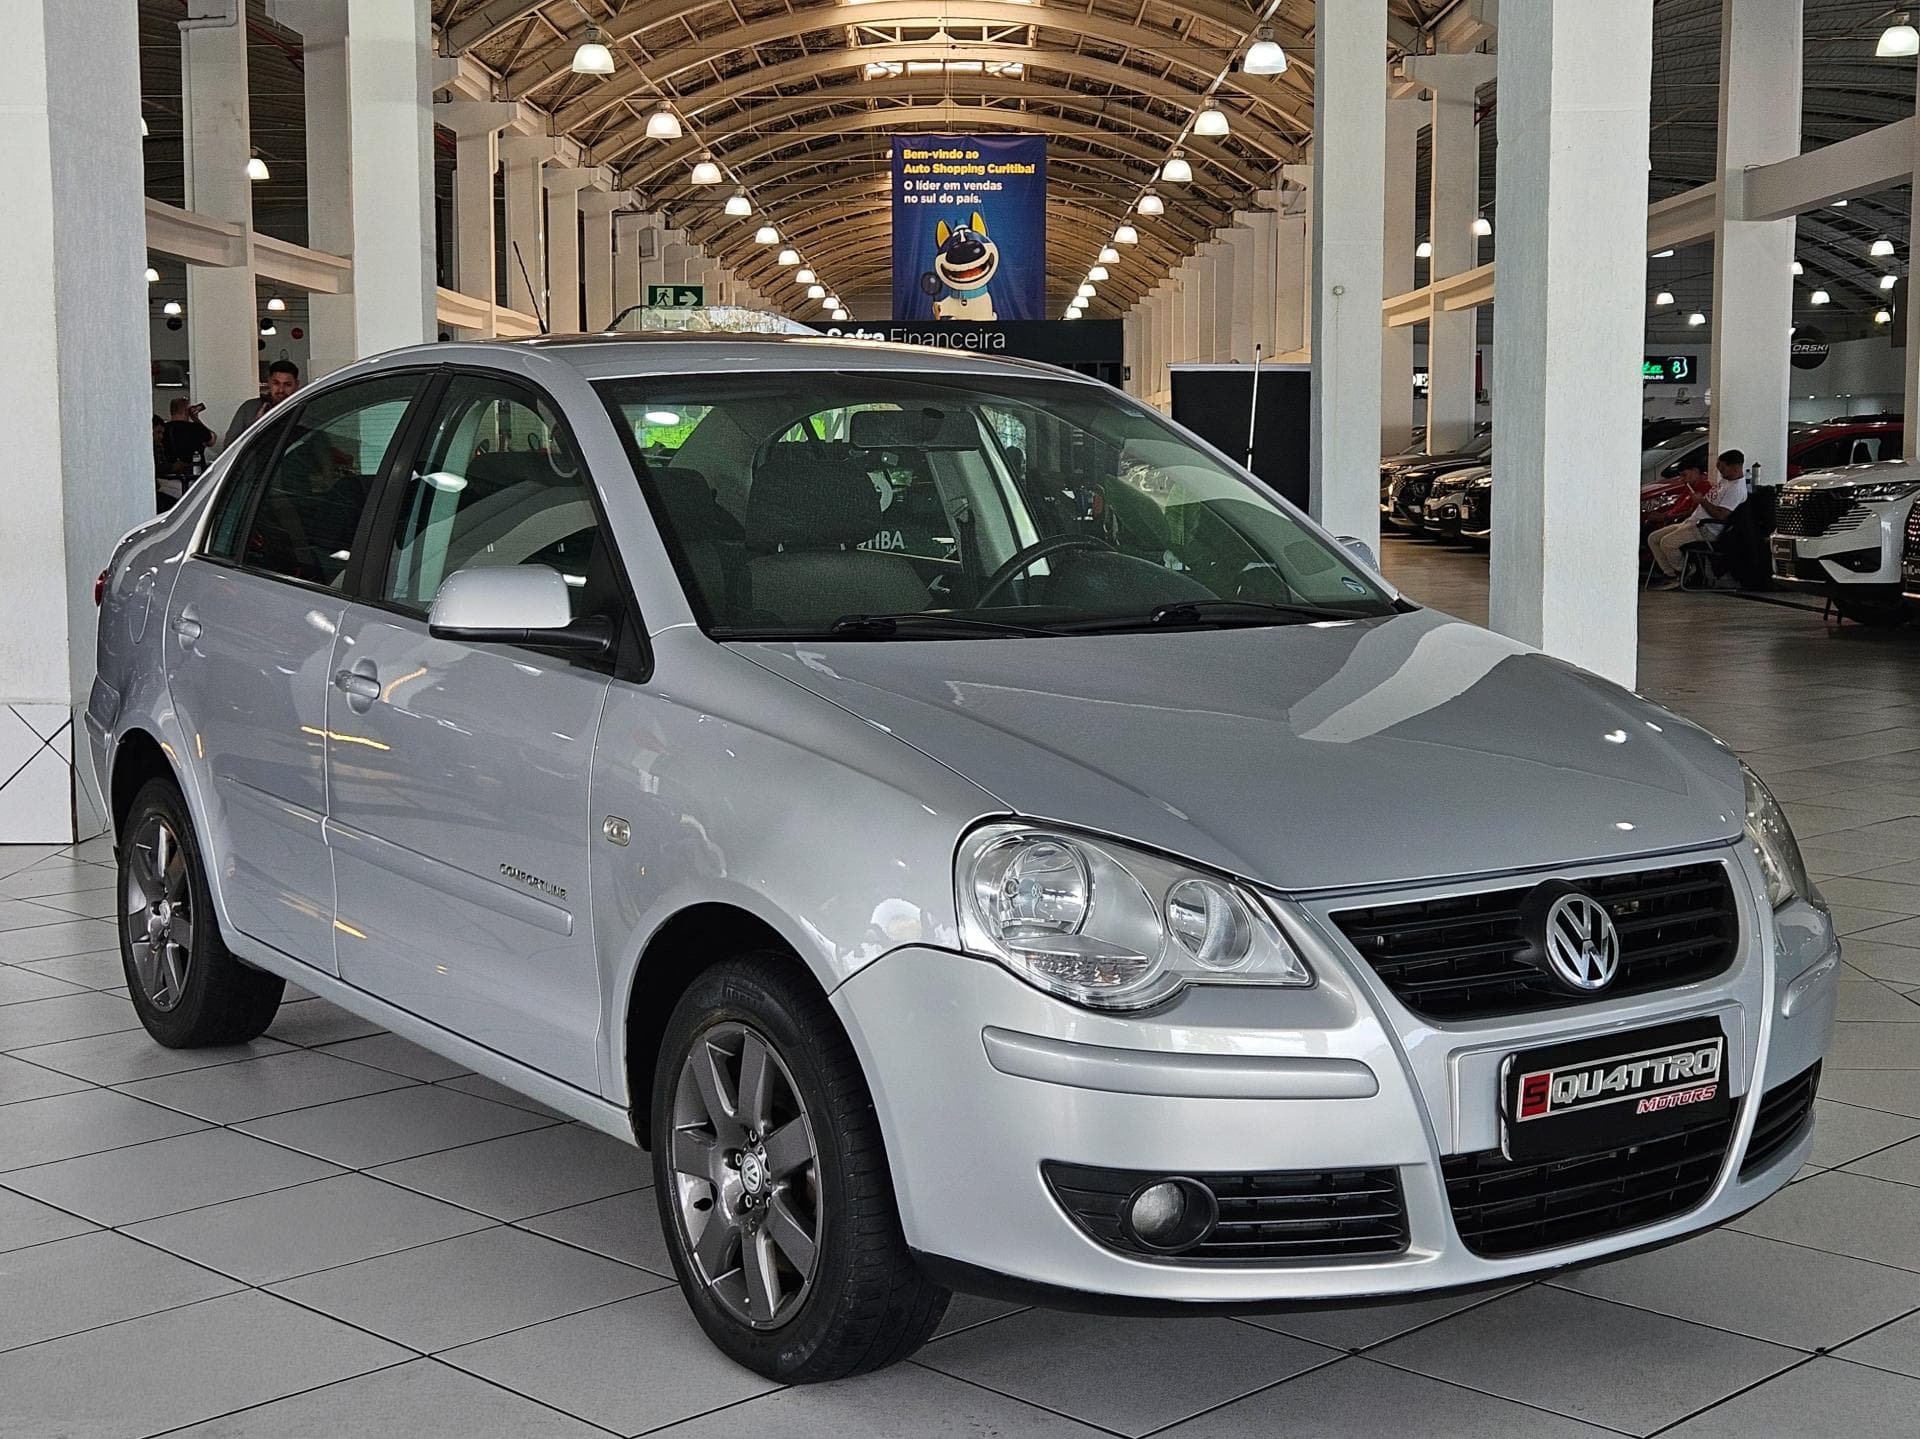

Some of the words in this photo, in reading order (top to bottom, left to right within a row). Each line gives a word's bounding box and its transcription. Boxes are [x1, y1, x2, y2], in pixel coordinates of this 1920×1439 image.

[903, 149, 964, 159] Bem-vindo
[965, 151, 980, 159] ao
[903, 163, 931, 174] Auto
[932, 163, 986, 175] Shopping
[987, 163, 1036, 174] Curitiba!
[903, 181, 914, 190] O
[916, 180, 941, 190] líder
[943, 182, 961, 190] em
[963, 180, 1003, 190] vendas
[903, 195, 918, 203] no
[920, 193, 936, 203] sul
[939, 193, 954, 203] do
[956, 193, 982, 205] país.
[890, 328, 1006, 348] Financeira
[1636, 1084, 1717, 1114] MOTORS
